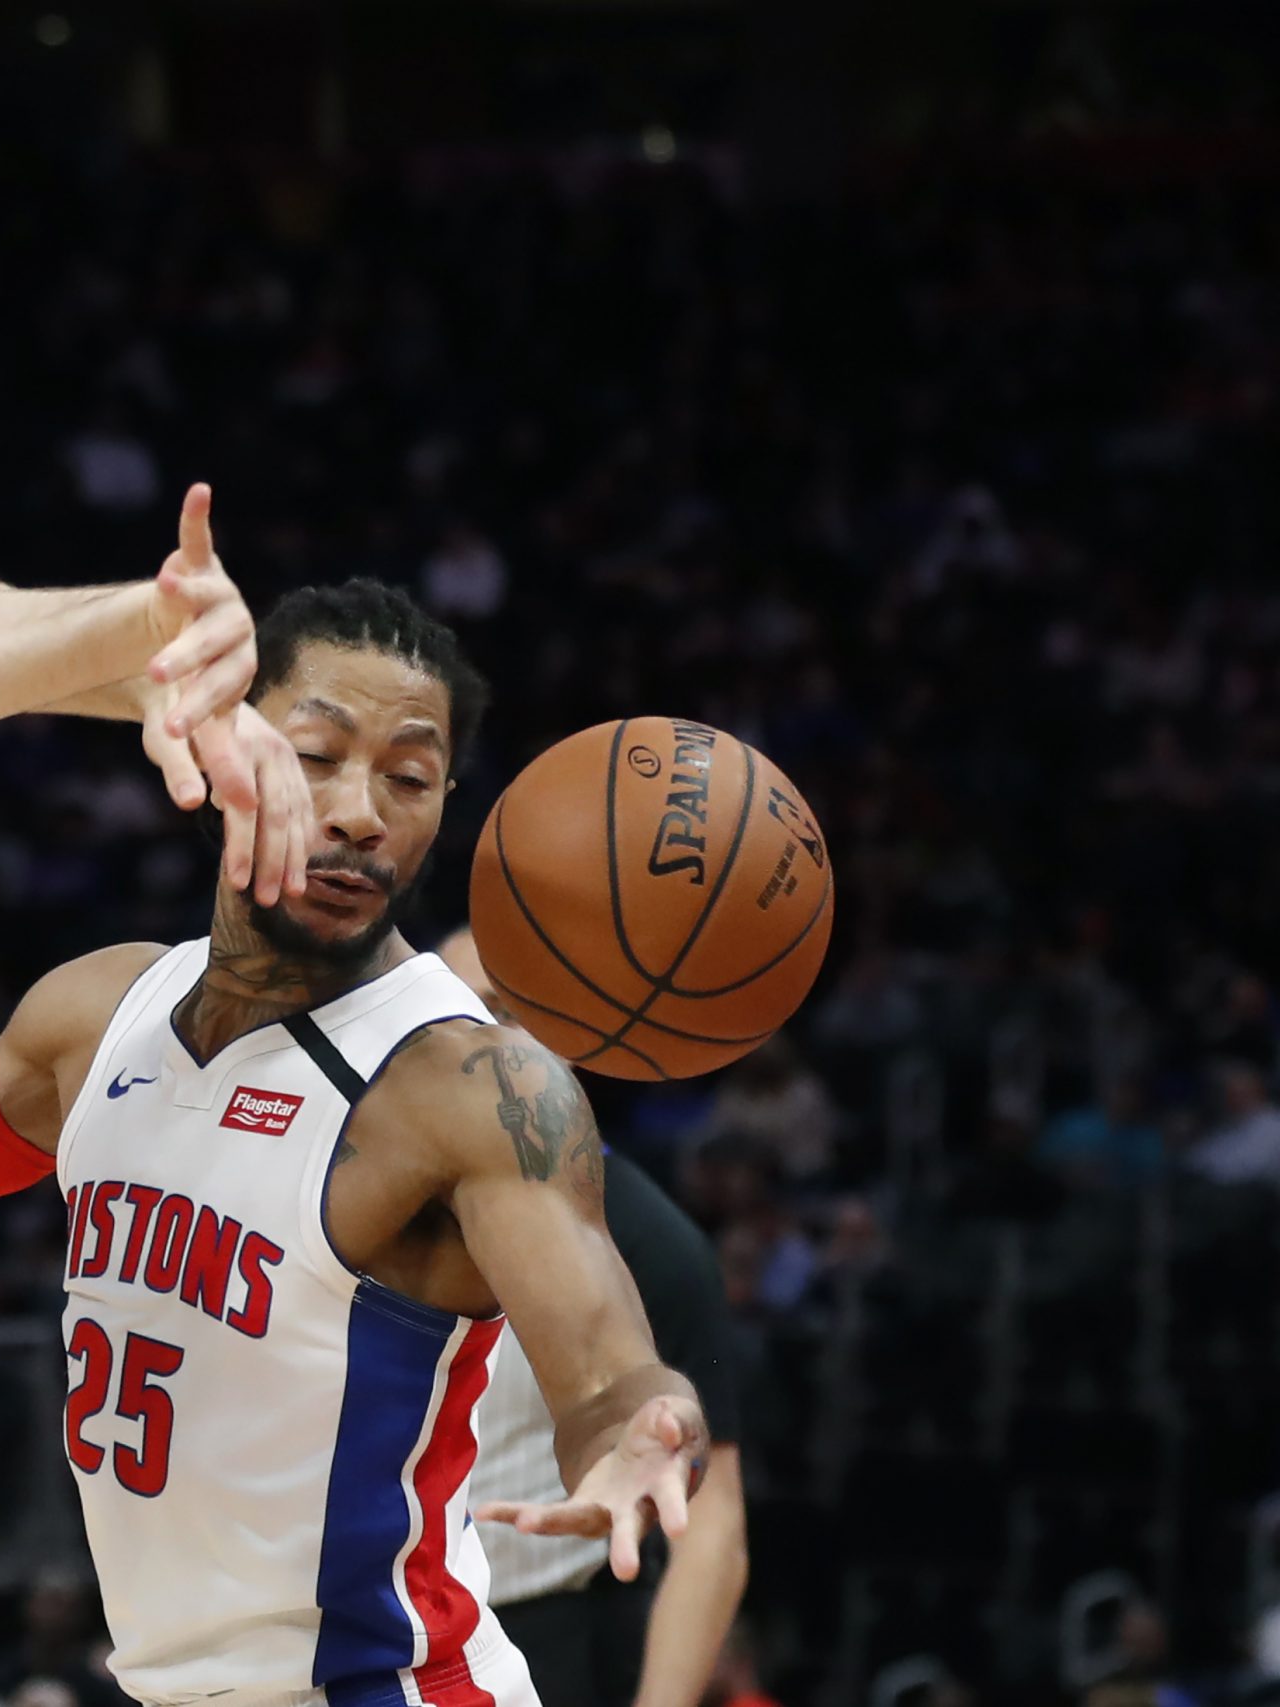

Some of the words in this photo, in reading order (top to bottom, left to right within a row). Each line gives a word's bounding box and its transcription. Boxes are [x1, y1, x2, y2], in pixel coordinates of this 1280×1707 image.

[232, 1092, 297, 1117] Flagstar
[264, 1118, 287, 1130] Bank
[66, 1180, 285, 1340] ISTONS
[66, 1316, 185, 1499] 25
